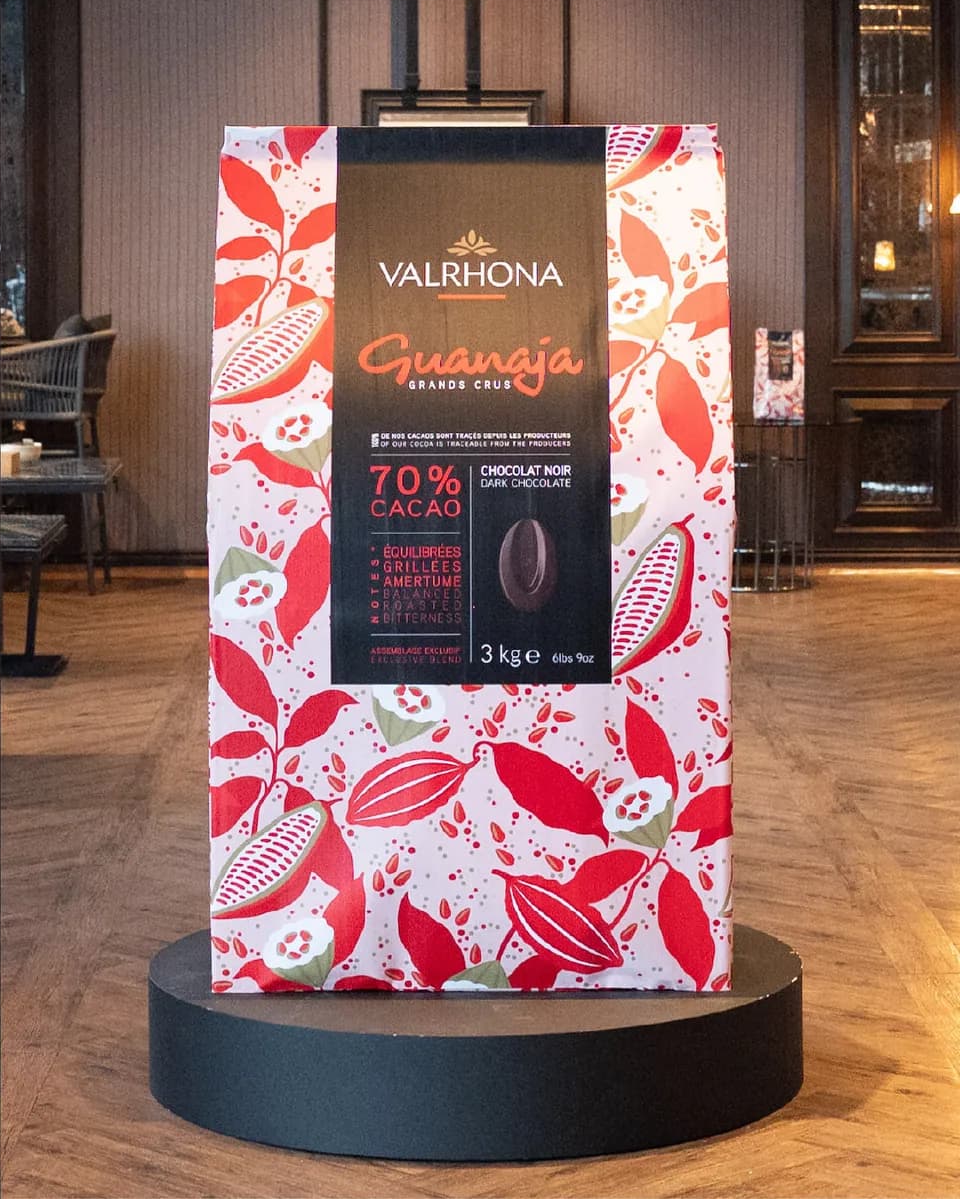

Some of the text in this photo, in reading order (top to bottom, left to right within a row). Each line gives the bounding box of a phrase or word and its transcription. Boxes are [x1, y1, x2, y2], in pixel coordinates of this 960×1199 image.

[379, 261, 563, 287] VALRHONA
[358, 333, 584, 397] Guanaja
[408, 379, 512, 390] GRANDS CRUS
[391, 432, 406, 440] NOS
[407, 432, 435, 440] CACAOS
[410, 440, 434, 448] COCOA
[480, 464, 571, 477] CHOCOLAT NOIR
[480, 478, 571, 489] DARK CHOCOLATE
[370, 498, 461, 518] CACAO
[383, 575, 461, 587] AMERTUME
[383, 588, 461, 599] BALANCED
[383, 600, 461, 611] ROASTED
[481, 643, 493, 663] 3
[499, 643, 521, 668] kg
[552, 652, 594, 663] 6lbs 9oz
